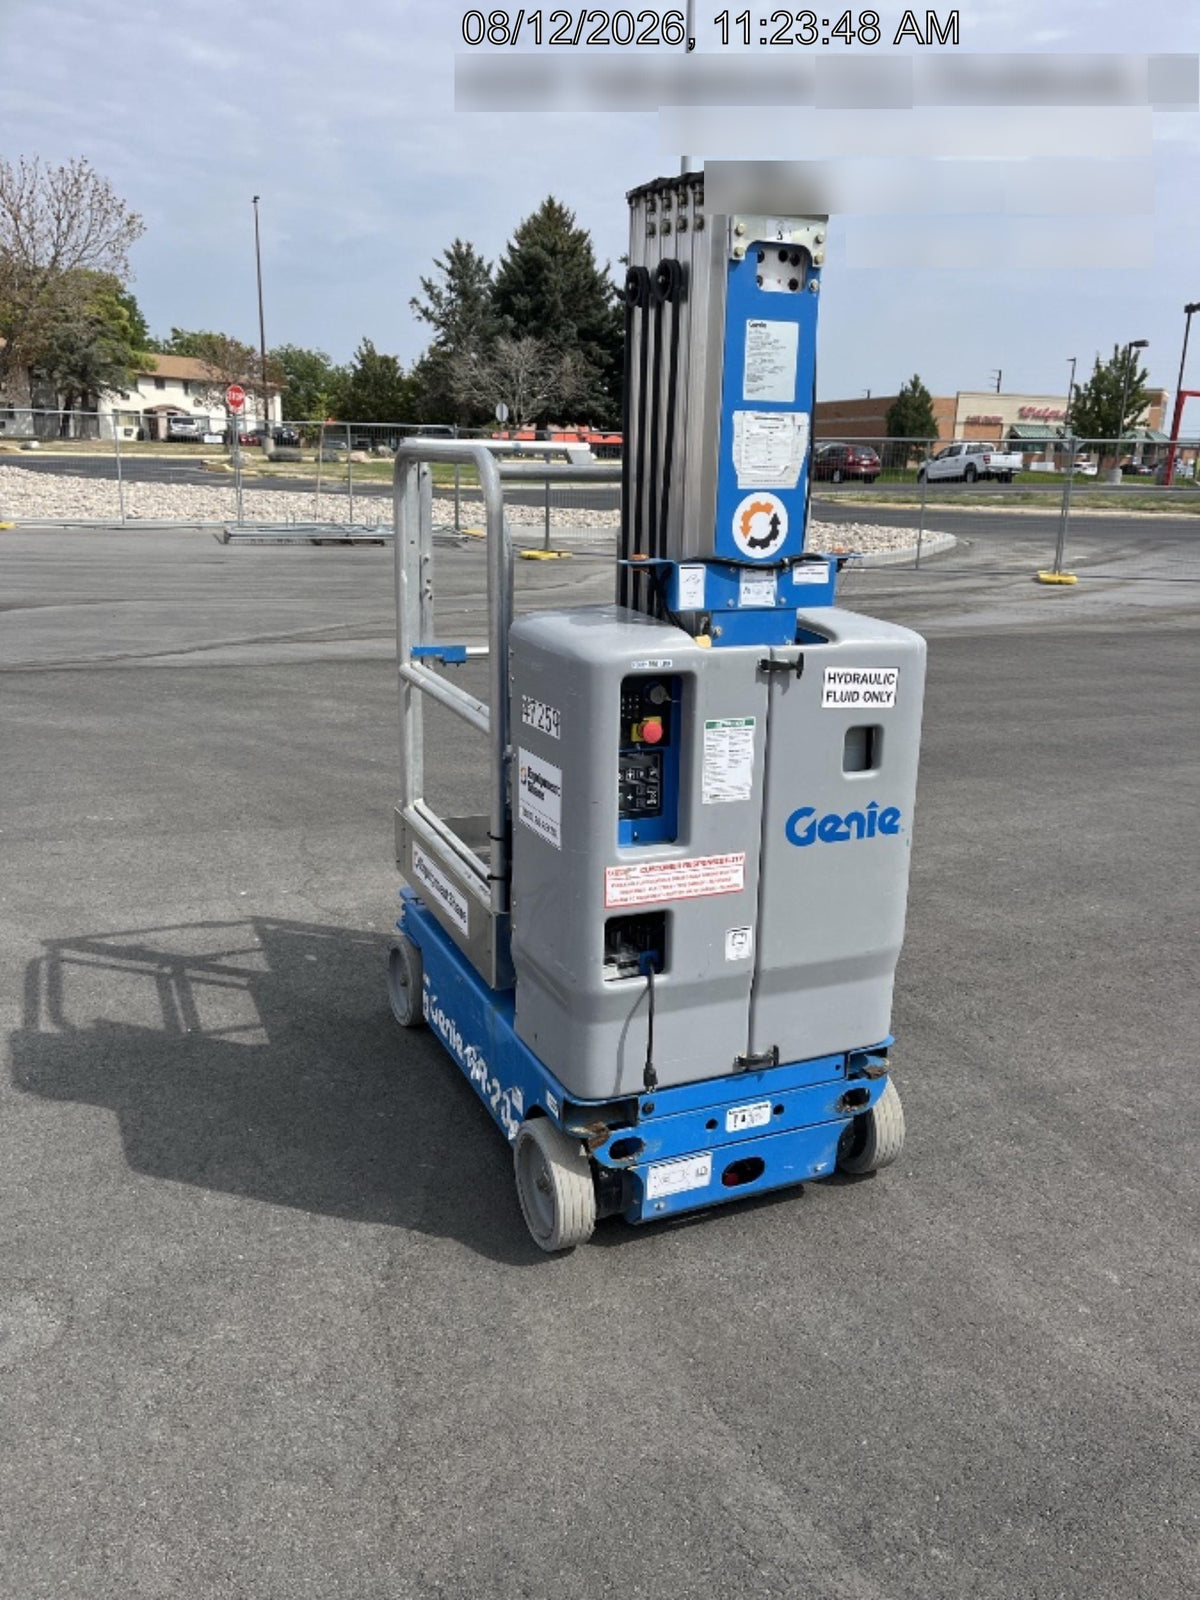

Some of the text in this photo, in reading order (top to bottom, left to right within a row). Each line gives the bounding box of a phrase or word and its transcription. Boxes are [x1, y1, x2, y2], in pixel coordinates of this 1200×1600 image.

[226, 391, 245, 401] STOP
[827, 673, 896, 686] HYDRAULIC
[826, 690, 894, 703] FLUID ONLY
[785, 801, 902, 847] Genie
